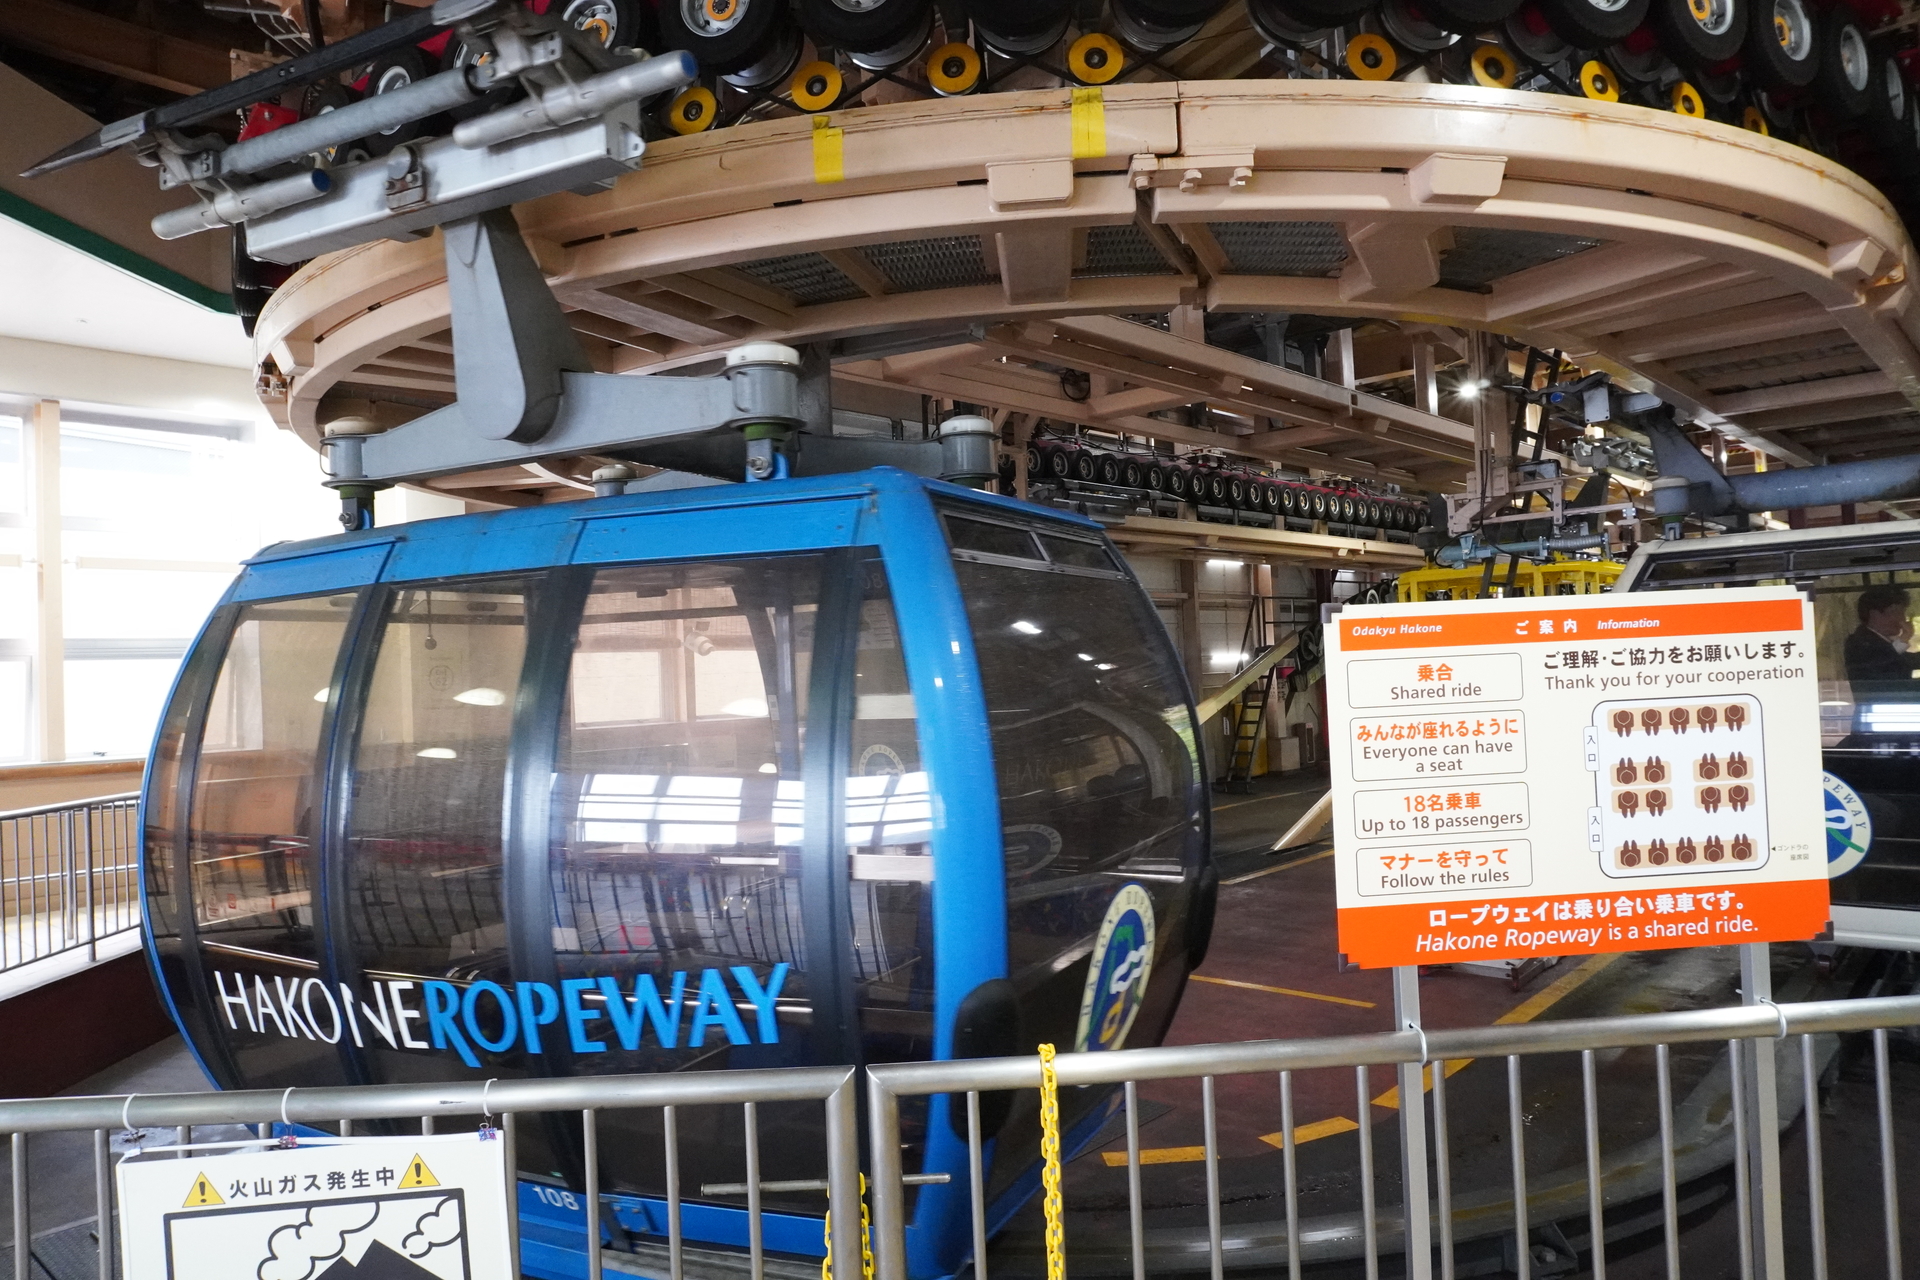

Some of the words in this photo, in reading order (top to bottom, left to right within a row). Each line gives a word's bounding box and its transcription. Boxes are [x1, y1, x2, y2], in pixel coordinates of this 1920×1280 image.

[1352, 626, 1395, 637] Odakyu
[1400, 624, 1442, 634] Hakone
[1597, 618, 1660, 630] Information
[1417, 663, 1453, 682] 乗合
[1545, 674, 1595, 690] Thank
[1600, 675, 1630, 691] you
[1636, 671, 1660, 686] for
[1665, 671, 1702, 688] your
[1707, 665, 1804, 684] cooperation
[1391, 684, 1446, 700] Shared
[1451, 683, 1482, 697] ride
[1357, 718, 1518, 742] みんなが座れるように
[1363, 745, 1437, 761] Everyone
[1443, 742, 1469, 755] can
[1475, 740, 1513, 754] have
[1587, 735, 1597, 762] 入口
[1416, 762, 1425, 772] a
[1430, 759, 1463, 772] seat
[1404, 792, 1482, 813] 18名乗車
[1823, 776, 1867, 829] PEWAY
[1362, 819, 1384, 835] Up
[1389, 818, 1406, 831] to
[1412, 815, 1429, 829] 18
[1435, 812, 1523, 831] passengers
[1591, 816, 1600, 842] 入口
[1380, 848, 1508, 870] マナーを守って
[1382, 870, 1434, 888] Follow
[1440, 871, 1466, 885] the
[1471, 868, 1510, 883] rules
[1429, 890, 1745, 927] ロープウェイは乗り合い乗車です。
[1416, 930, 1498, 952] Hakone
[1505, 926, 1602, 950] Ropeway
[1608, 923, 1622, 940] is
[1628, 926, 1639, 939] a
[1645, 917, 1709, 938] shared
[1715, 915, 1759, 934] ride.
[229, 1164, 395, 1199] 火山ガス発生中
[532, 1184, 580, 1210] 108
